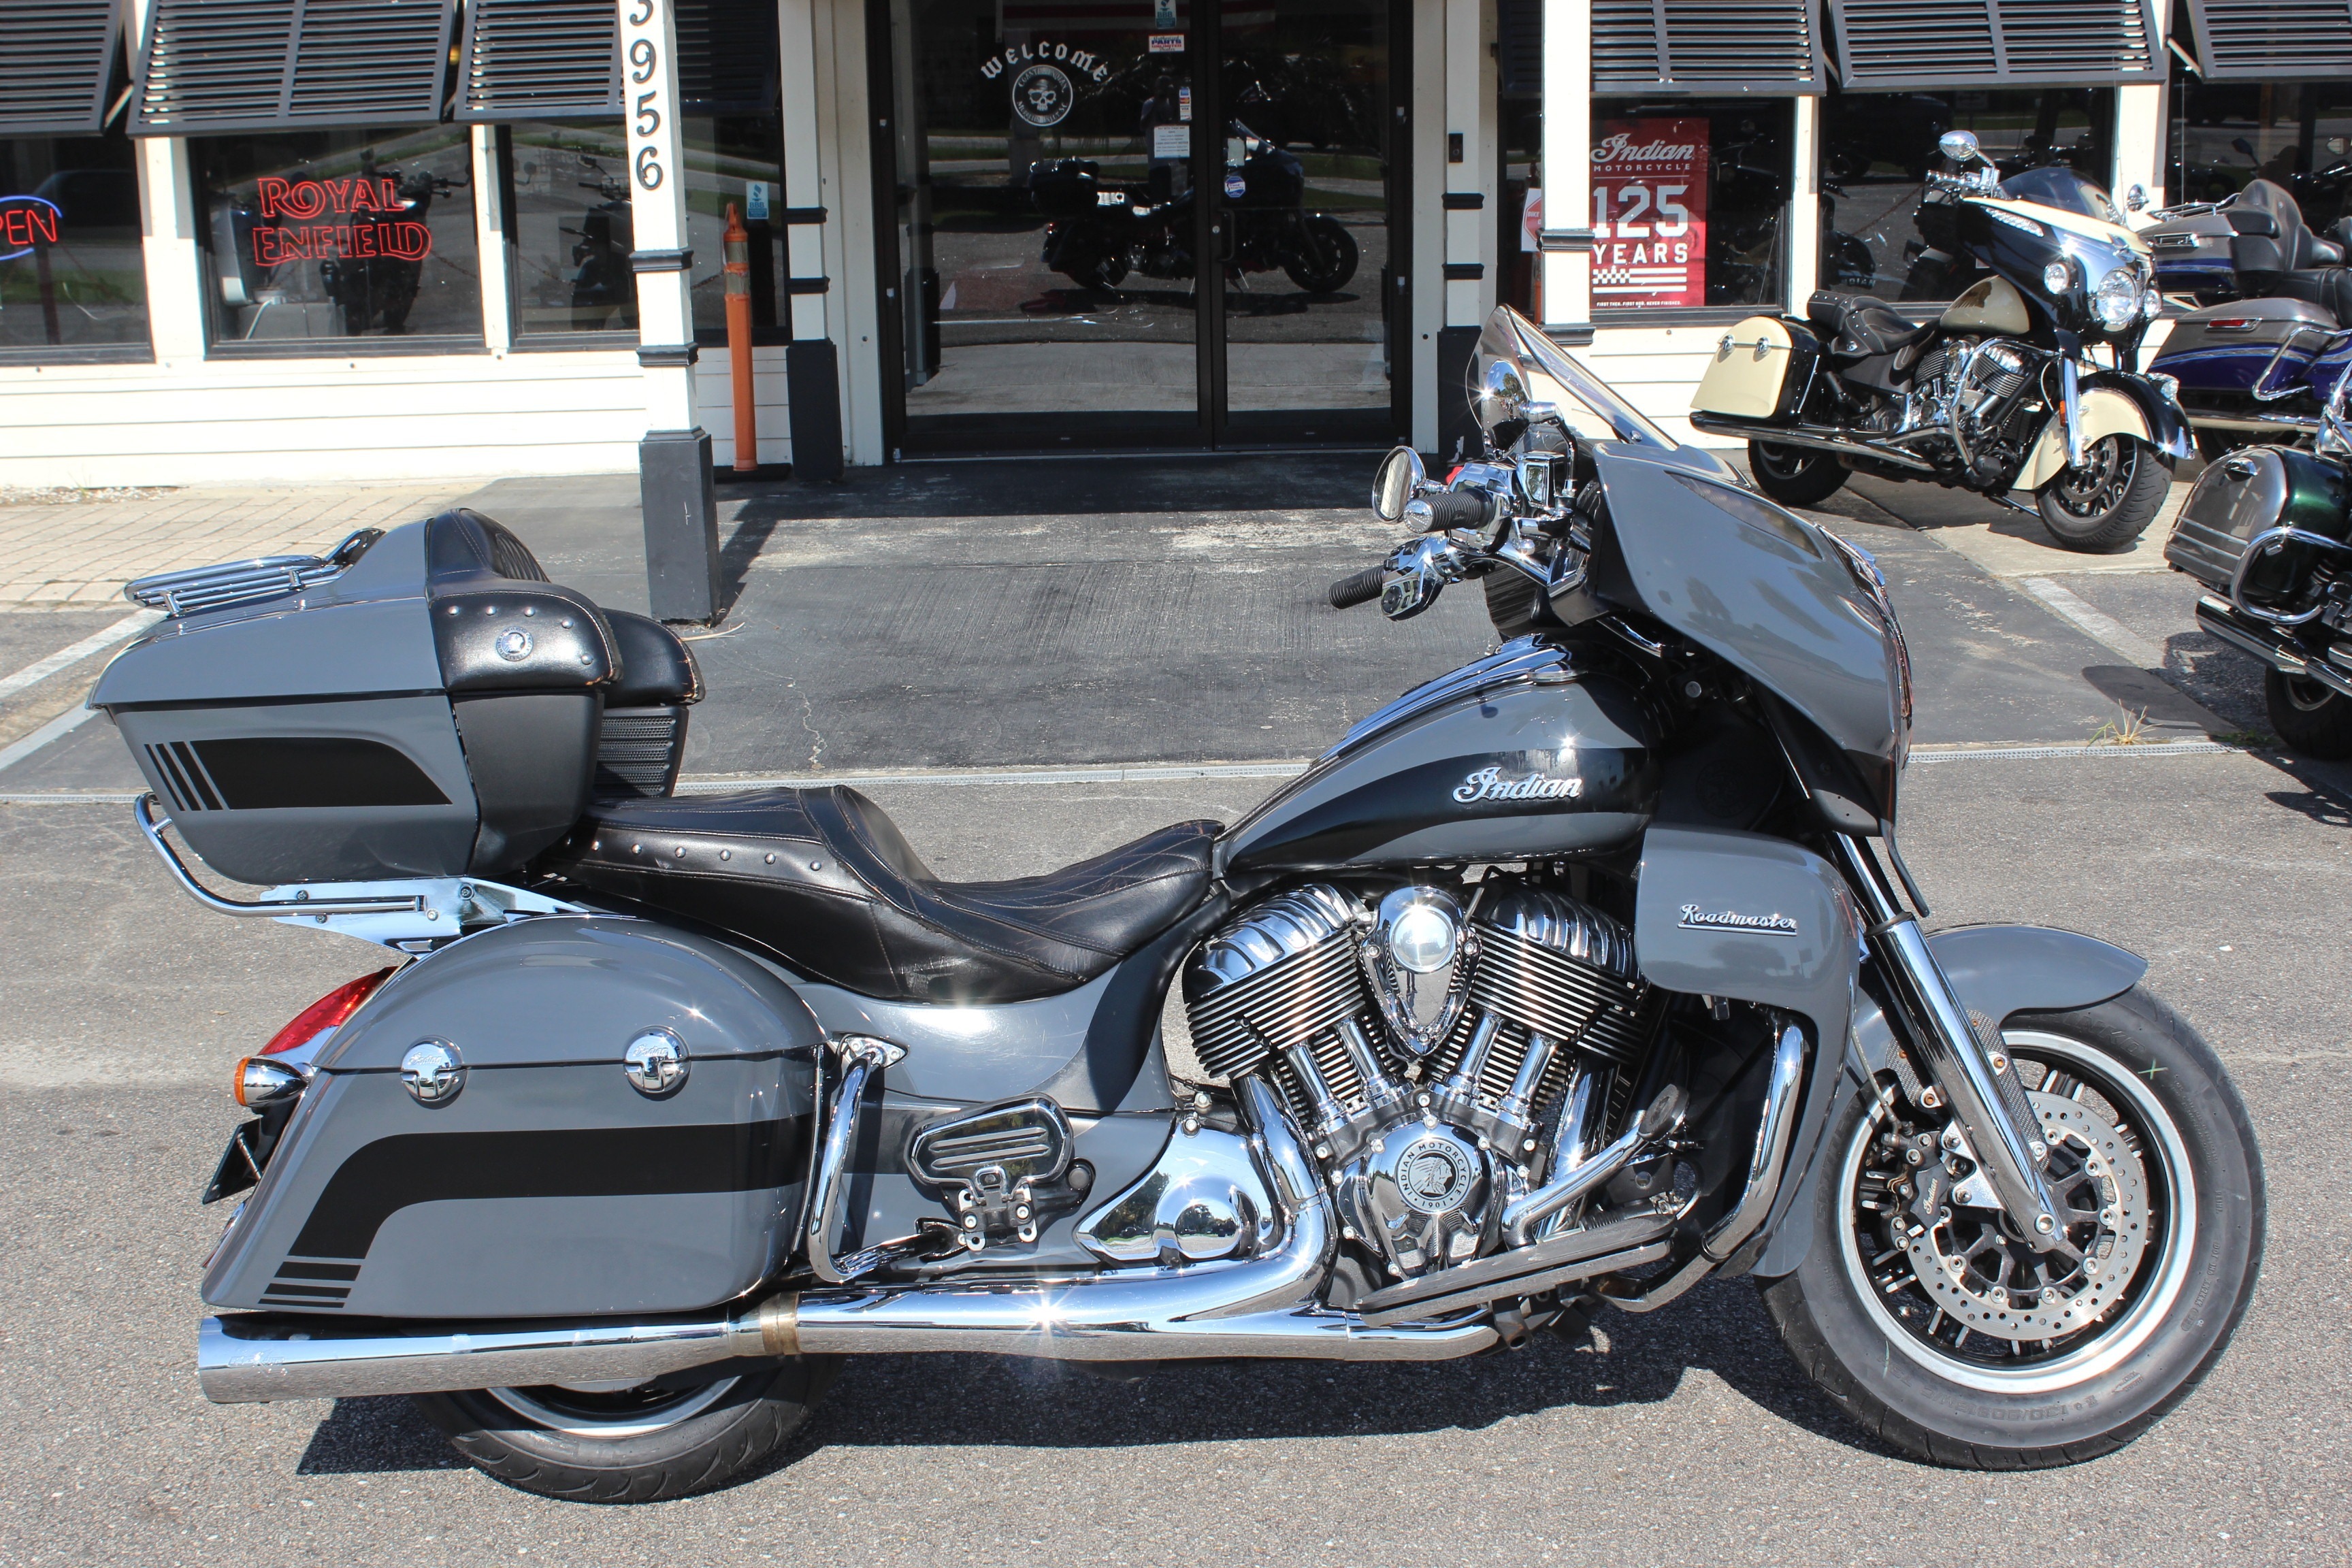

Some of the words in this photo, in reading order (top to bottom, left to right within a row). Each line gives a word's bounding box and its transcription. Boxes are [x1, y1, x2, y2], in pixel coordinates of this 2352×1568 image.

[981, 41, 1108, 82] WELCOME
[1590, 133, 1695, 163] Indian
[1593, 163, 1690, 172] MOTORCYCLE
[257, 178, 407, 218] ROYAL
[1592, 184, 1689, 238] 125
[0, 208, 57, 246] EN
[252, 222, 432, 267] ENFIELD
[1592, 242, 1688, 265] YEARS
[1452, 766, 1583, 803] Indian
[1680, 904, 1797, 928] Roadmaster
[1401, 1152, 1415, 1196] INDIAN
[1418, 1142, 1467, 1196] MOTORCYCLE
[1923, 1178, 1938, 1215] Indian
